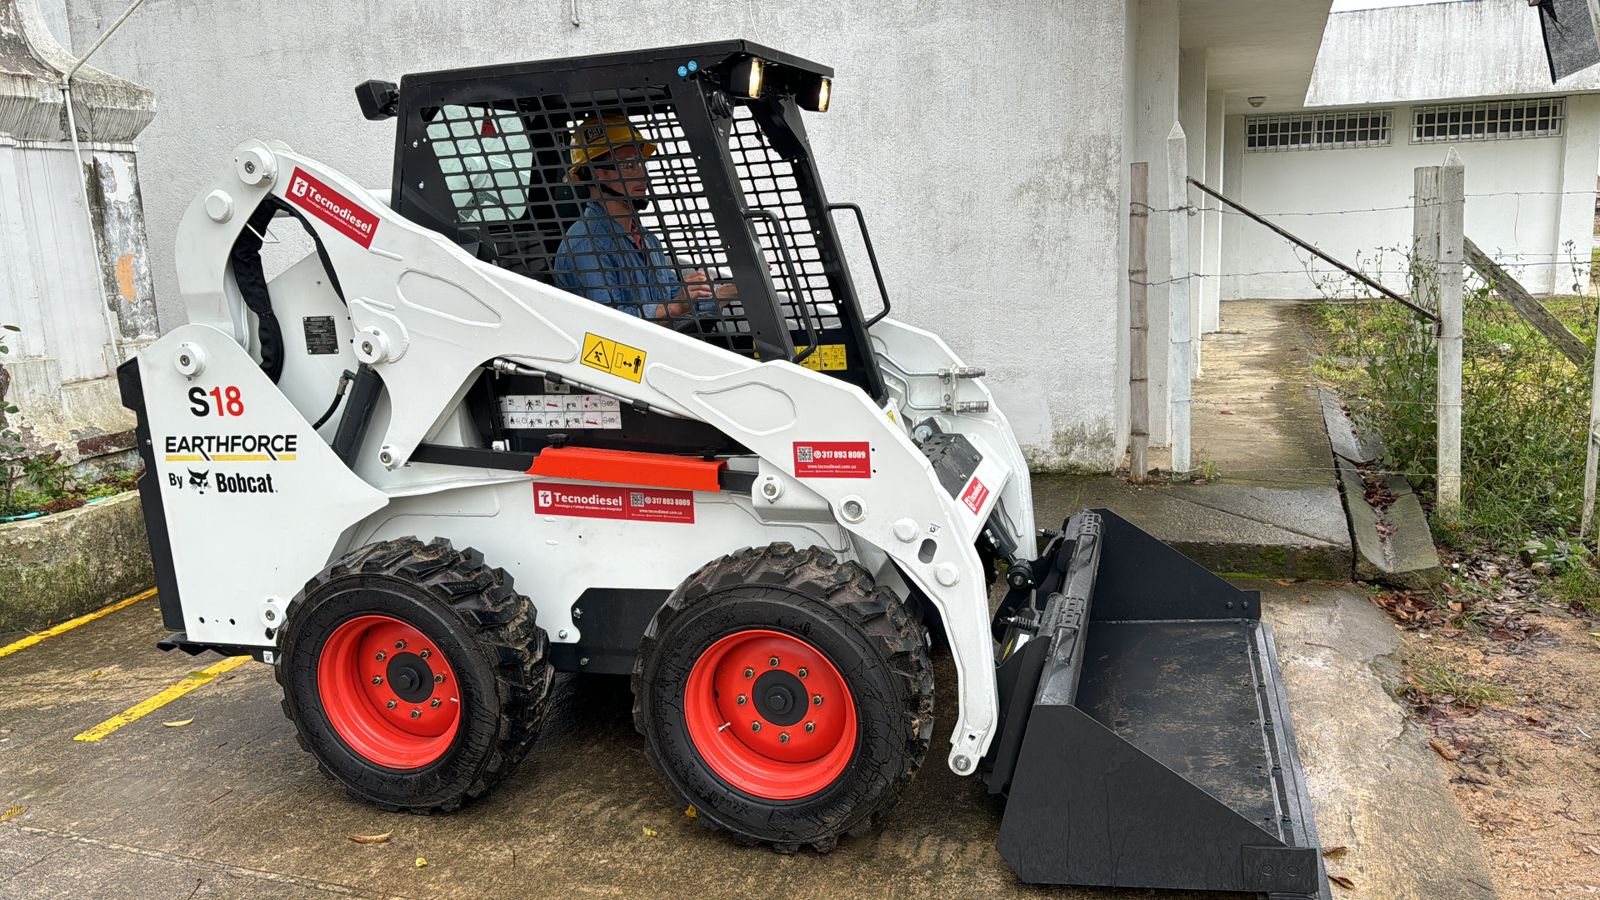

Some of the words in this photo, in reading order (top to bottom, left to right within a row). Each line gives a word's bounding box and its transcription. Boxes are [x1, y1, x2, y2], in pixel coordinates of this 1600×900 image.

[309, 186, 372, 234] Tecnodiesel
[188, 386, 245, 417] S18
[165, 435, 297, 461] EARTHFORCE
[822, 451, 833, 459] 317
[834, 451, 847, 459] 893
[168, 472, 183, 489] By
[215, 472, 275, 494] Bobcat
[553, 492, 623, 507] Tecnodiesel
